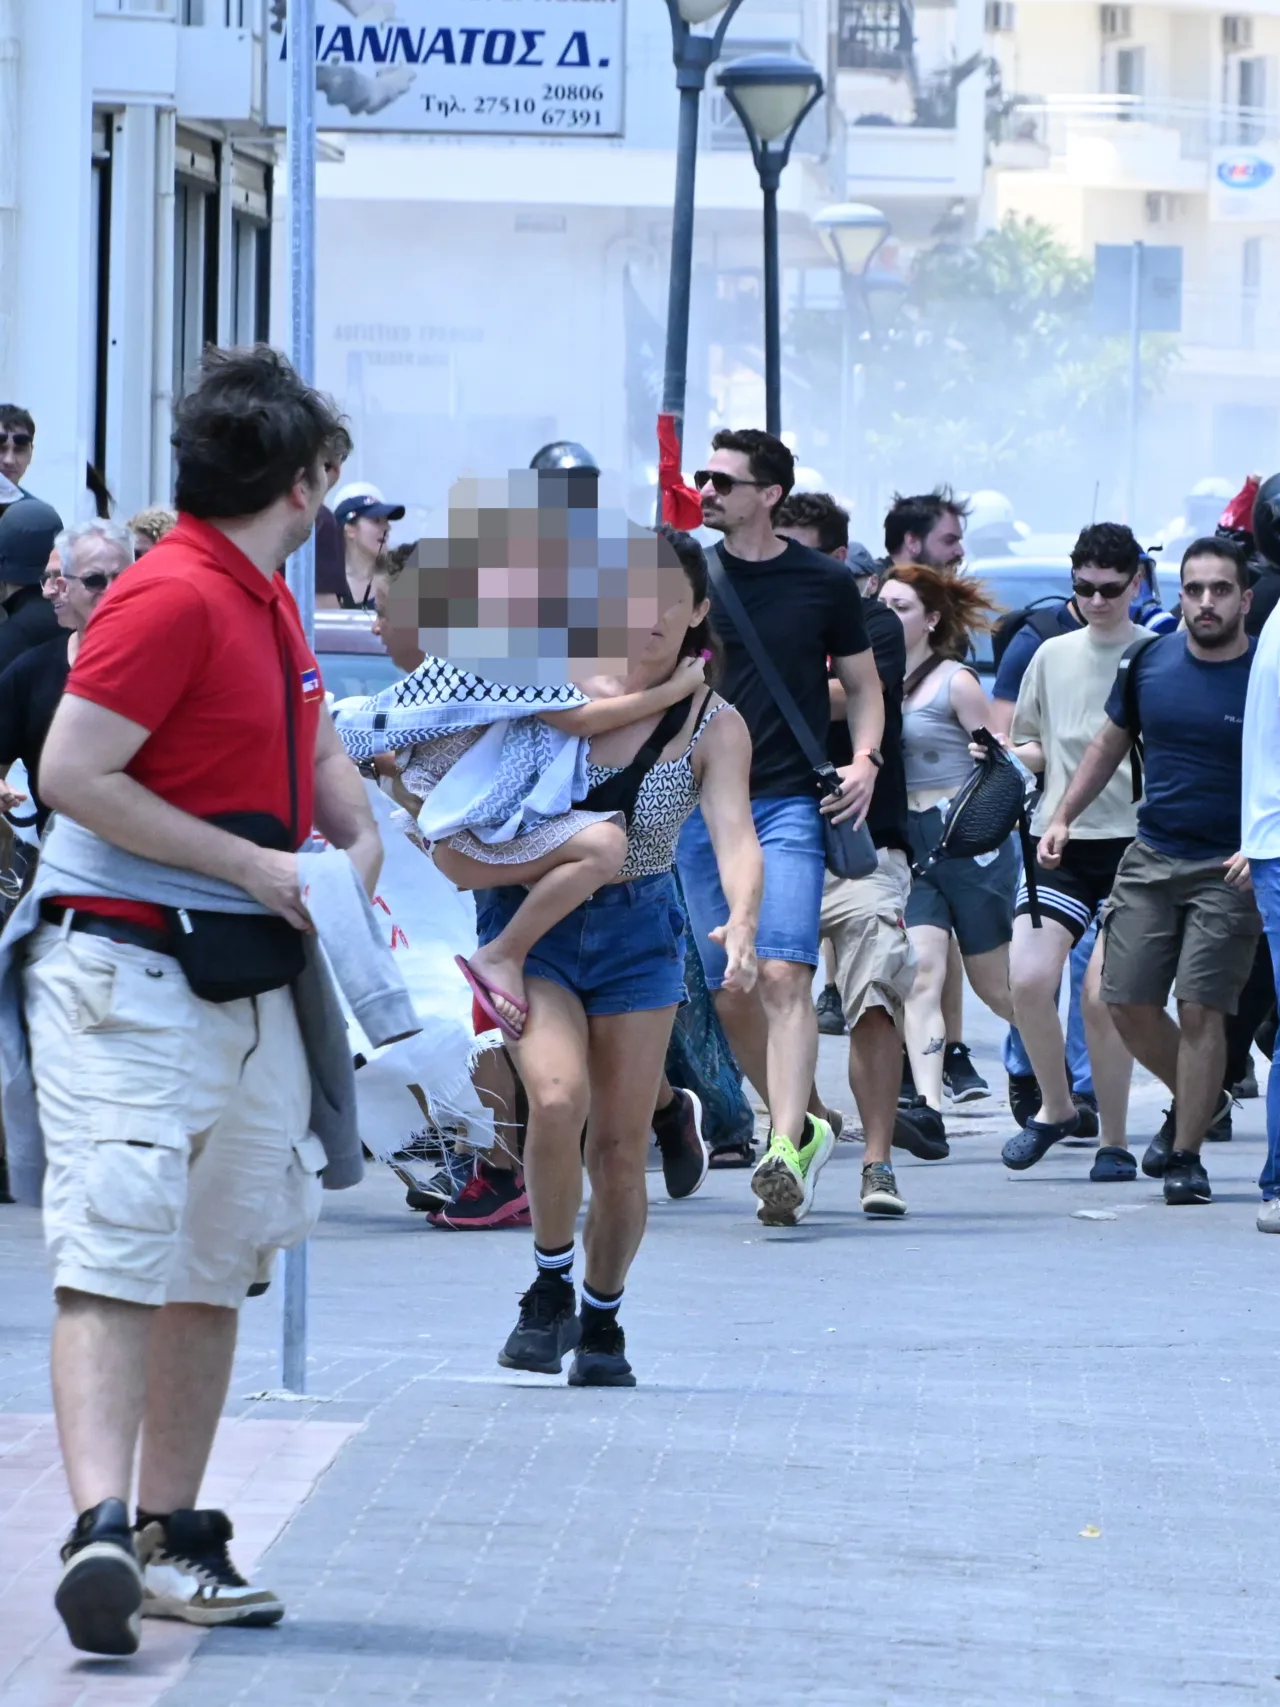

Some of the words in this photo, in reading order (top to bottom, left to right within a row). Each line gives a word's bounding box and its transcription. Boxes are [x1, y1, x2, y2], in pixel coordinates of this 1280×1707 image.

[280, 24, 546, 67] ΑΝΝΑΤΟΣ
[557, 30, 610, 68] Δ.
[541, 82, 604, 102] 20806
[420, 93, 466, 118] Τηλ.
[473, 96, 537, 116] 27510
[541, 107, 602, 127] 67391
